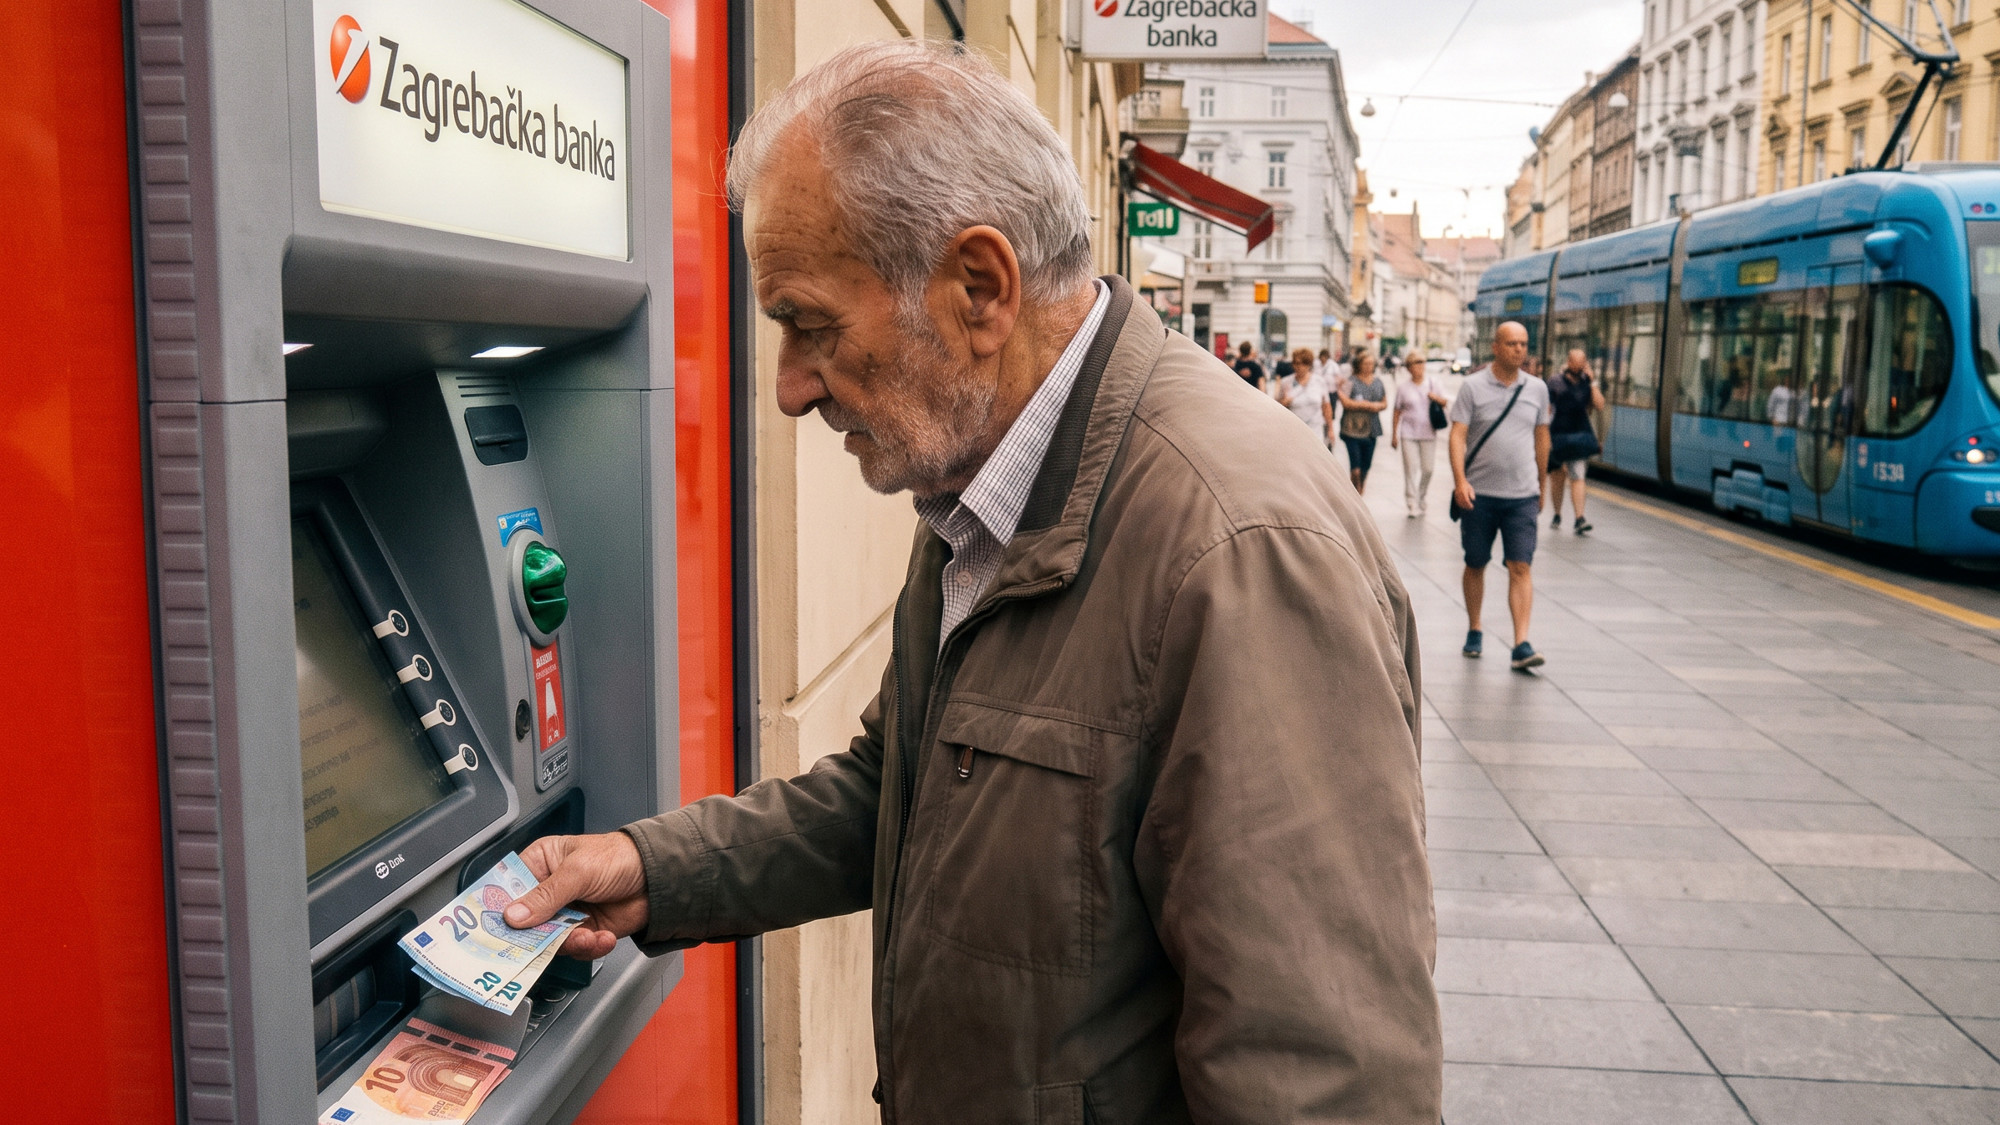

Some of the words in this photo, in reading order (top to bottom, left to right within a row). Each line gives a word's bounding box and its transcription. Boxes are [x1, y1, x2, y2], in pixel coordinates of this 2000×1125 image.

[1147, 24, 1218, 47] banka
[379, 36, 546, 159] Zagrebačka
[554, 103, 615, 181] banka
[439, 905, 478, 942] 20
[474, 971, 502, 992] 20
[495, 981, 522, 1001] 20
[365, 1067, 406, 1094] 10
